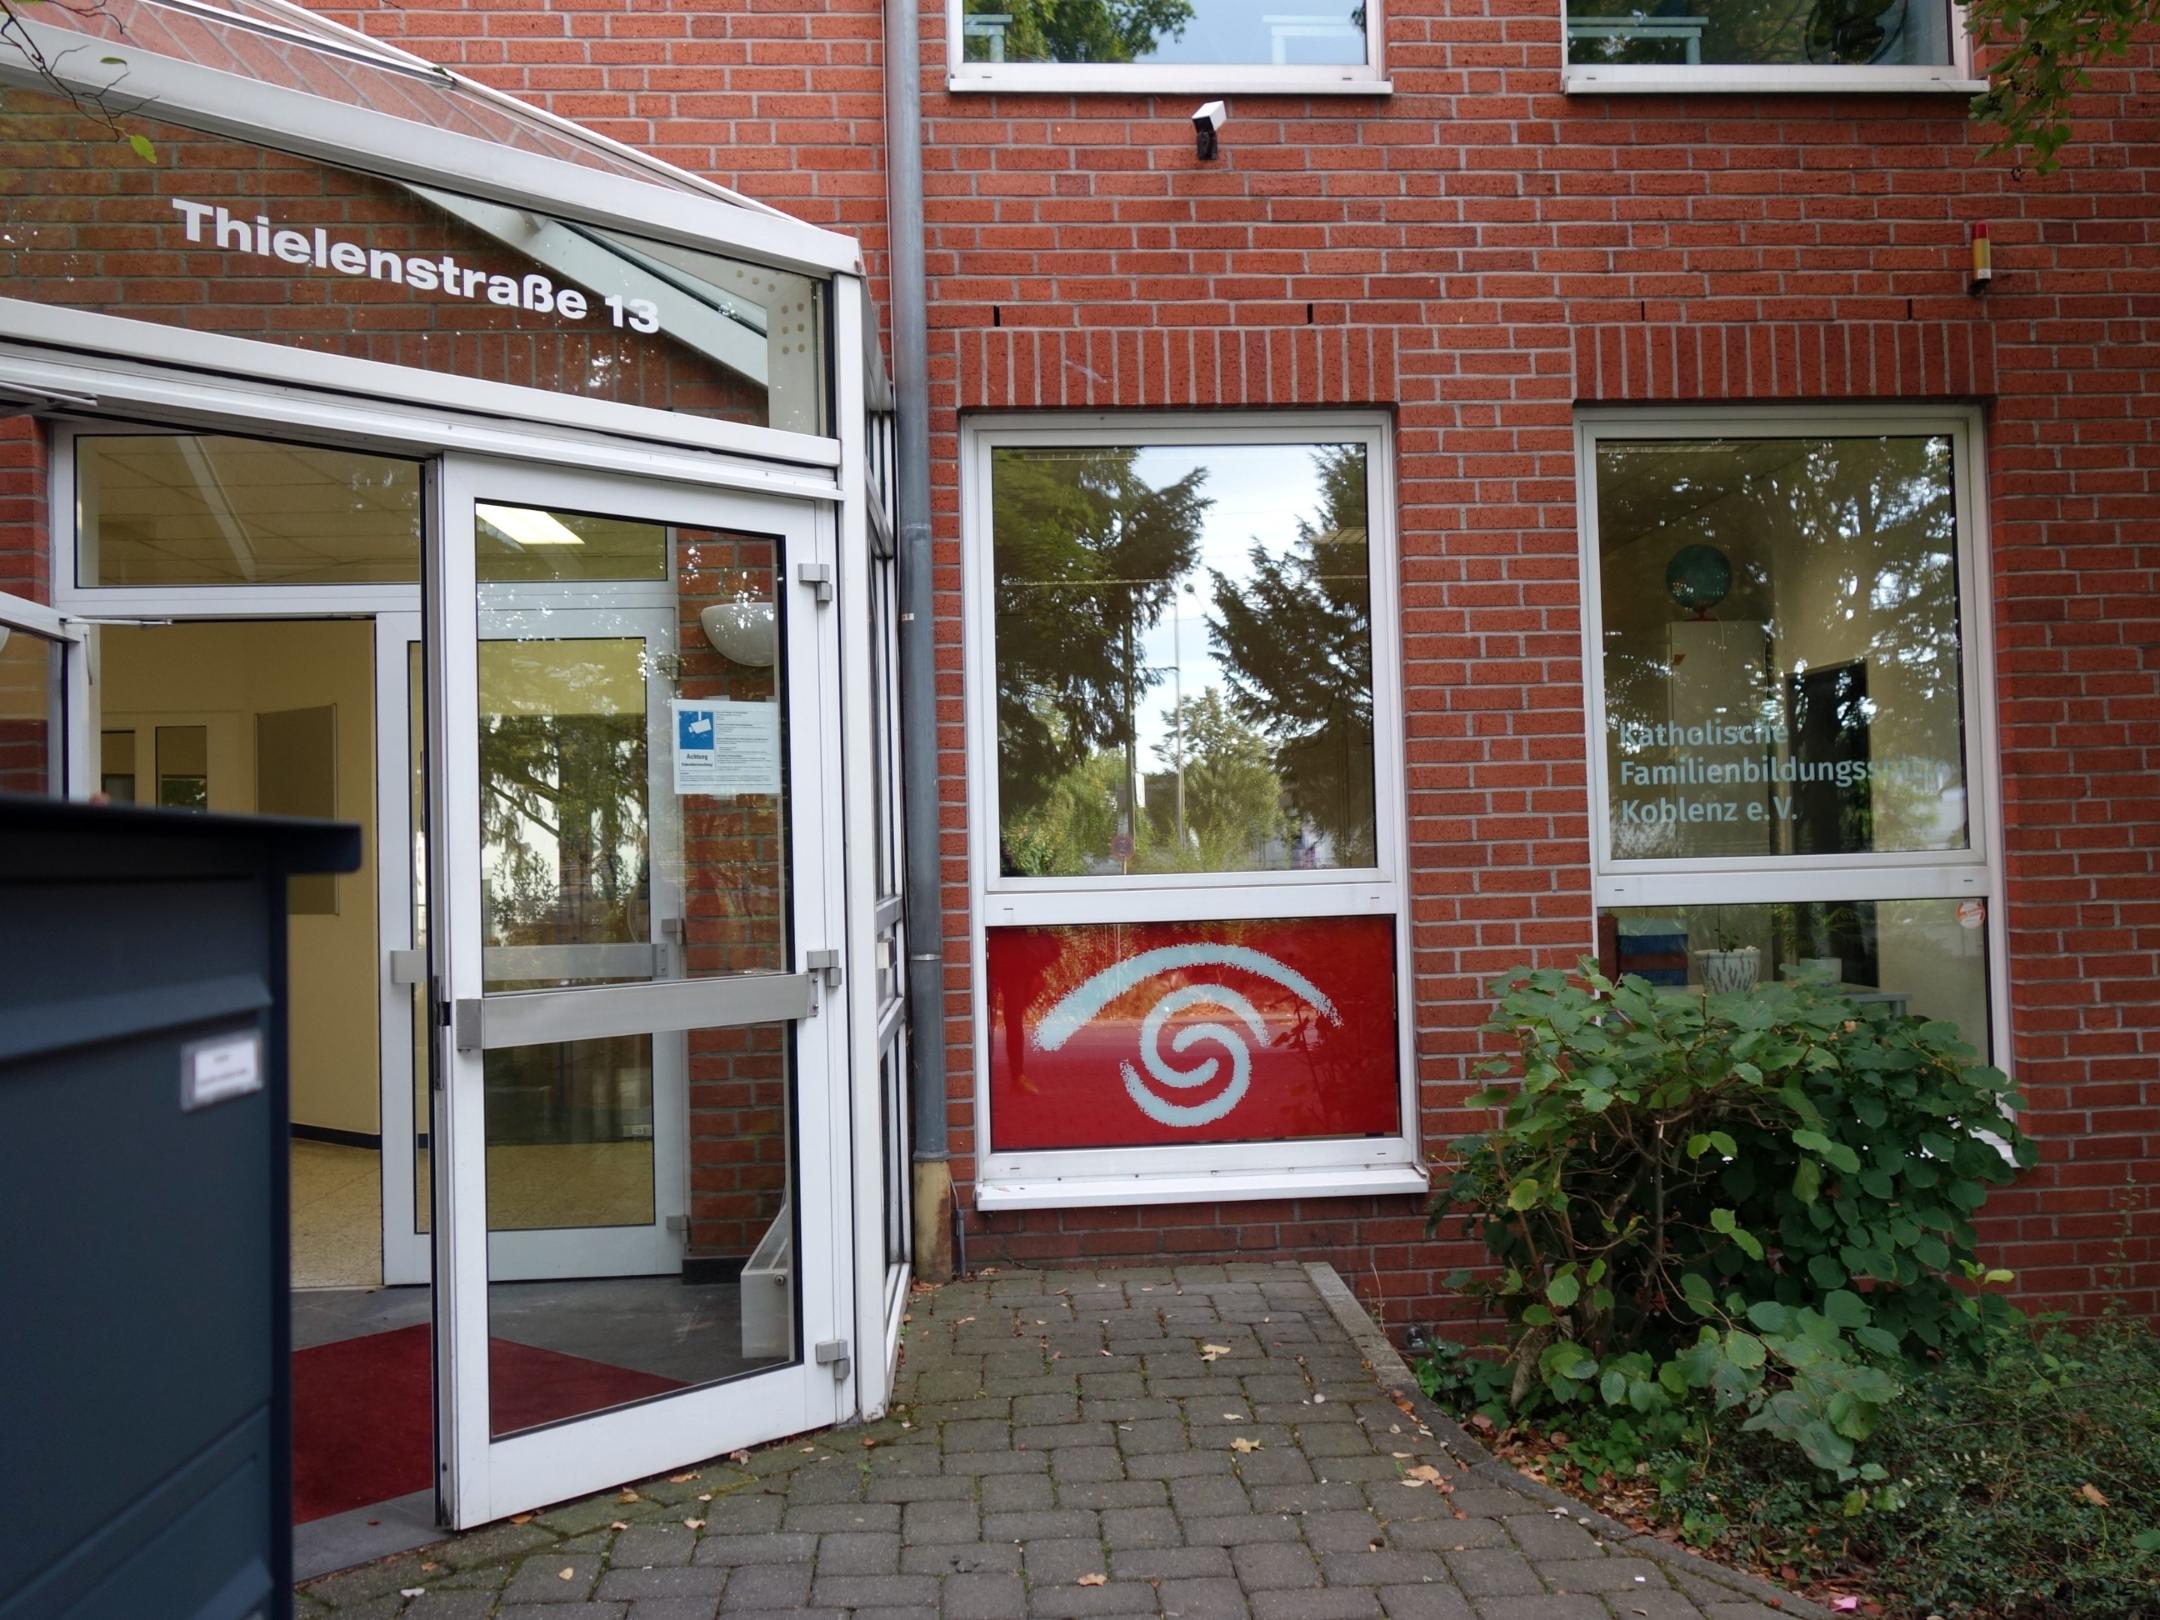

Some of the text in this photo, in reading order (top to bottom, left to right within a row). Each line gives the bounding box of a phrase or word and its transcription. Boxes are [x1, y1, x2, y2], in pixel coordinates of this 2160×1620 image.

[172, 198, 661, 334] Thielenstraße 13
[1620, 718, 1789, 747] Katholische
[1622, 797, 1738, 824] Koblenz
